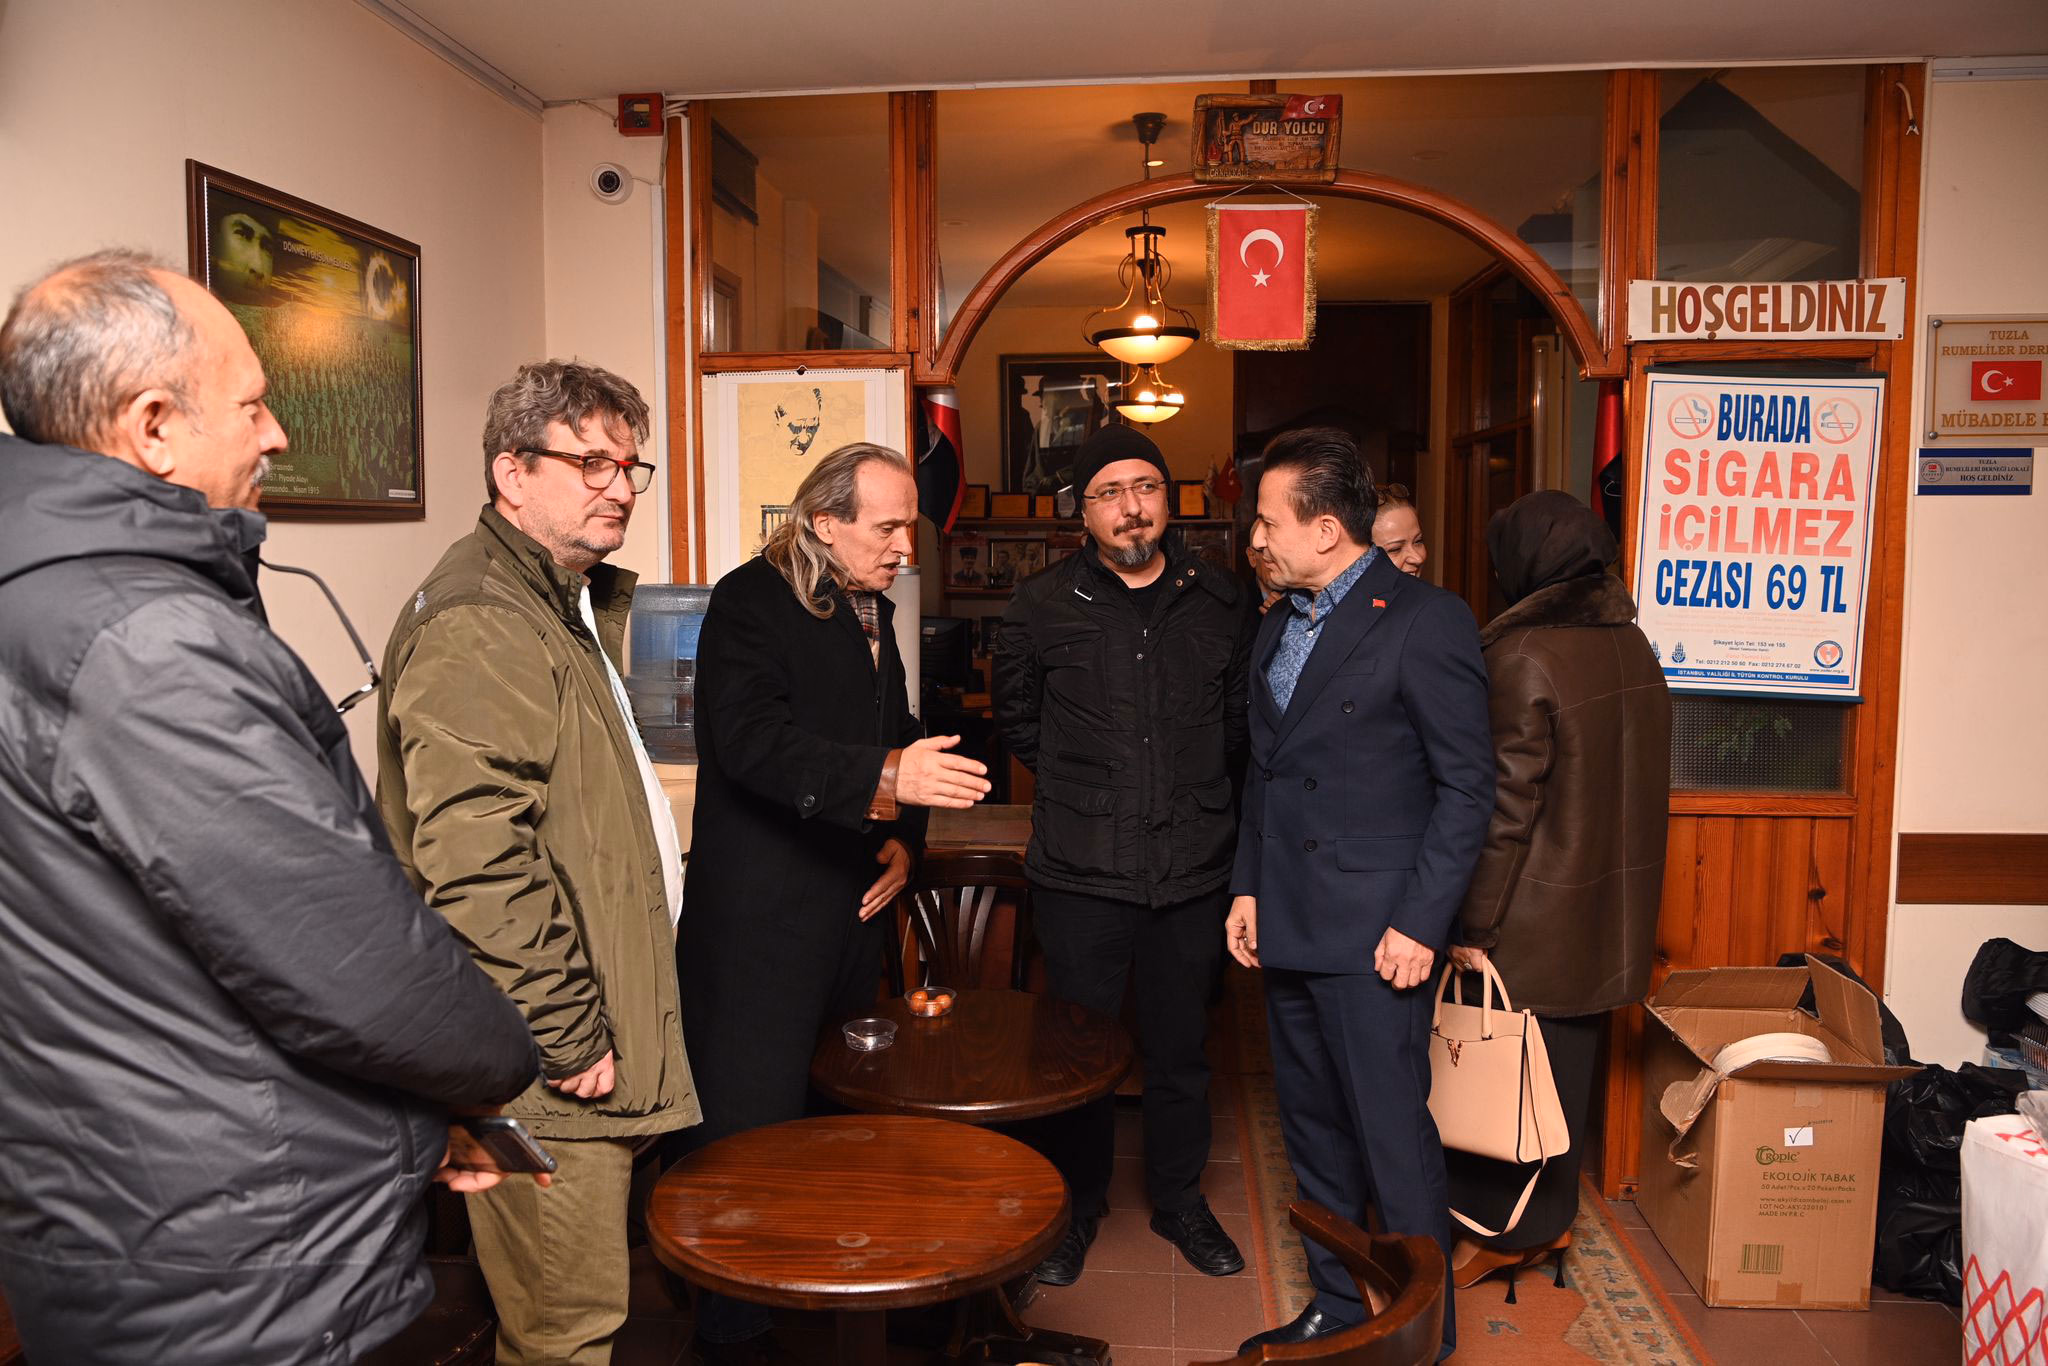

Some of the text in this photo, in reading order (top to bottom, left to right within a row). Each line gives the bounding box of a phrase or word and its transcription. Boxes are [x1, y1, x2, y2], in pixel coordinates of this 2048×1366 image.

[1252, 121, 1325, 135] DUR YOLCU
[1651, 279, 1887, 338] HOŞGELDİNİZ
[1989, 330, 2029, 340] TUZLA
[1942, 344, 2015, 356] RUMELİLER
[1717, 393, 1811, 443] BURADA
[1941, 409, 2037, 427] MÜBADELE
[1960, 474, 2014, 482] HOŞ GELDİNİZ
[1655, 558, 1846, 613] CEZASI 69 TL
[1713, 639, 1734, 648] Şikayet
[1677, 669, 1706, 677] İSTANBUL
[1706, 670, 1731, 678] VALİLİĞİ
[1737, 671, 1756, 679] TÜTÜN
[1762, 1169, 1856, 1182] EKOLOJİK TABAK
